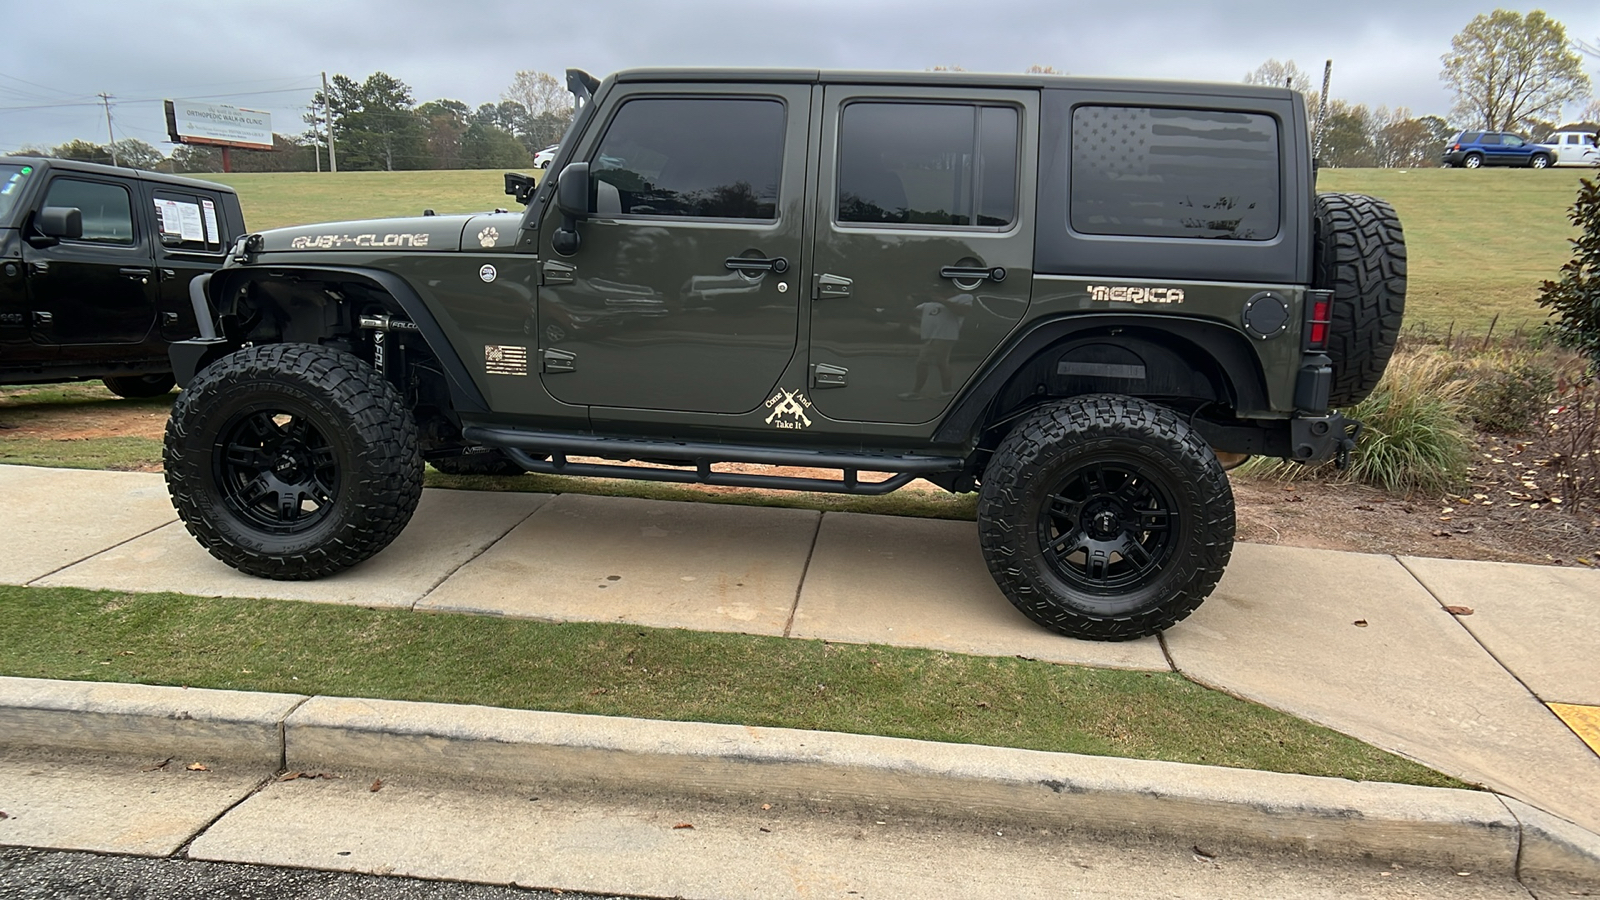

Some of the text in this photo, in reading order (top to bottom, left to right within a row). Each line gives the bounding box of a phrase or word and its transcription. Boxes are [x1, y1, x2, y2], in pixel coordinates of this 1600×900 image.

[187, 109, 222, 120] ORTHOPEDIC
[246, 117, 263, 126] CLINIC
[0, 313, 22, 324] eep
[765, 393, 812, 409] Come And
[775, 420, 802, 430] Take It
